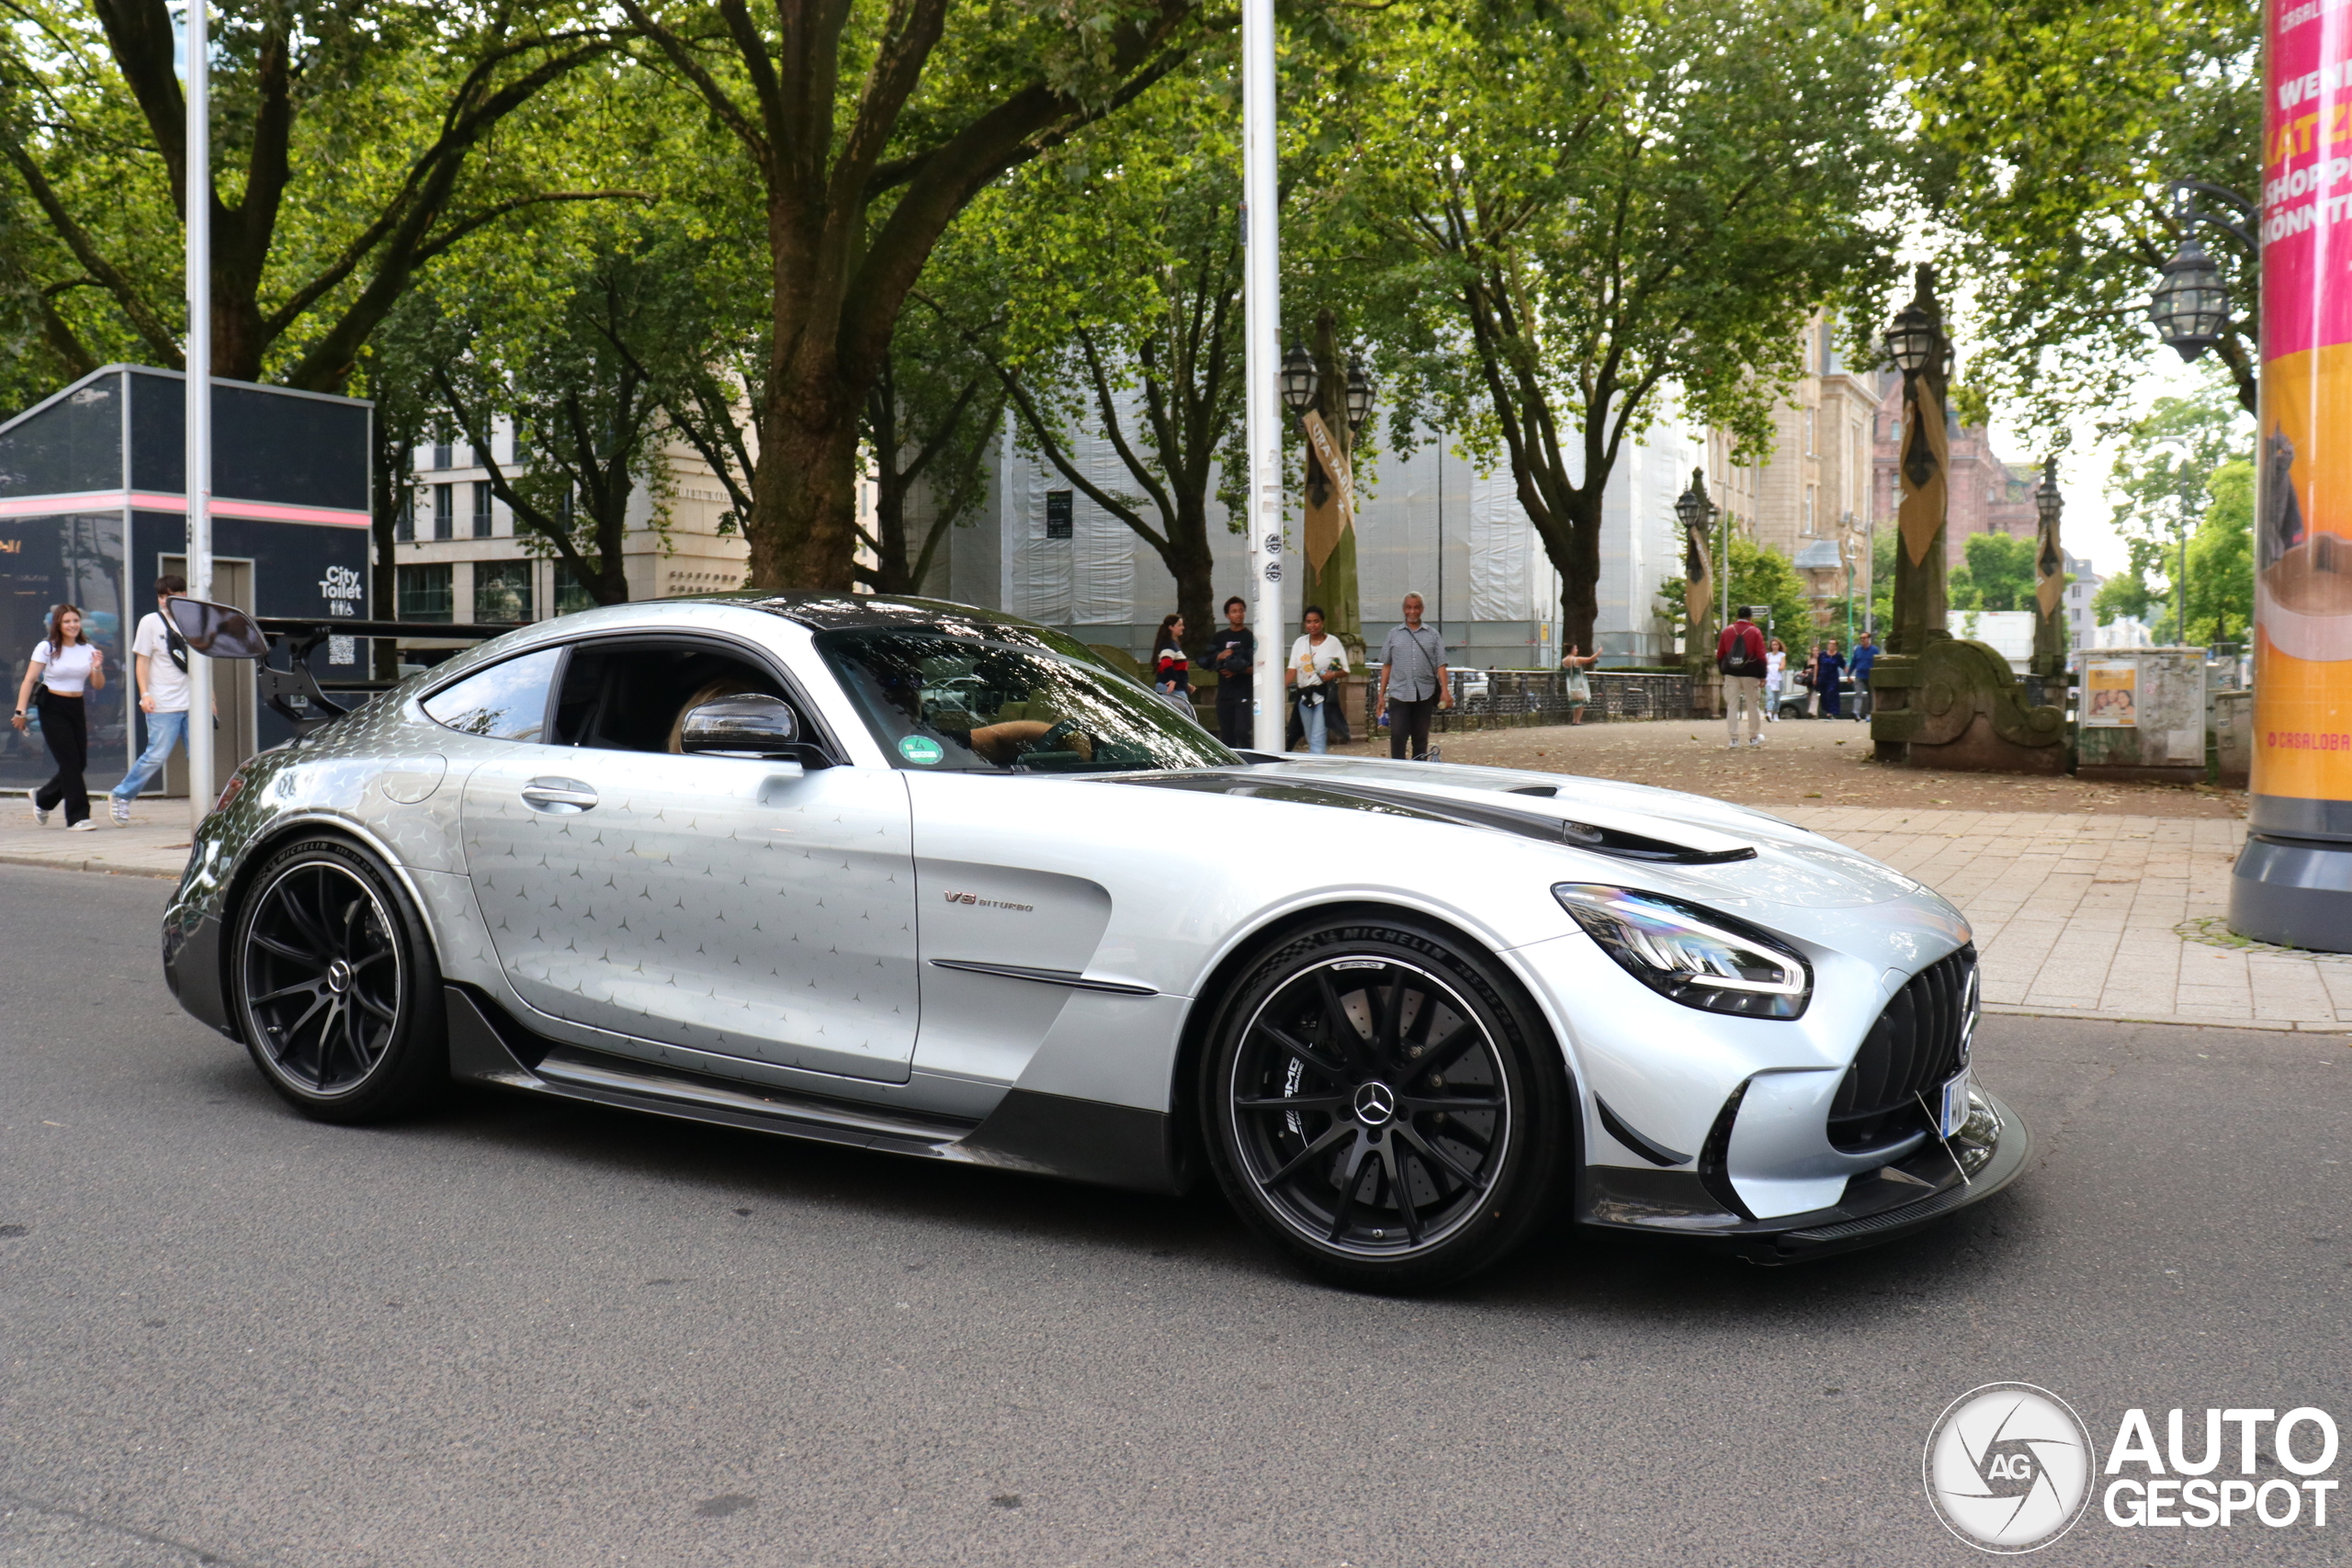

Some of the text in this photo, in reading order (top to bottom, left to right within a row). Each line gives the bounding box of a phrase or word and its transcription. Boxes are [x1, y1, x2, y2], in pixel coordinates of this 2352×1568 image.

[2278, 59, 2352, 109] WEN
[2265, 153, 2352, 209] SHOPP
[326, 565, 359, 587] City
[318, 580, 363, 600] Toilet
[914, 739, 925, 750] 4
[2279, 731, 2350, 751] CASALOBA
[277, 841, 329, 863] MICHELIN
[944, 889, 1034, 912] V8 BITURBO
[1342, 929, 1449, 960] MICHELIN
[1294, 1063, 1305, 1093] CERAMIC
